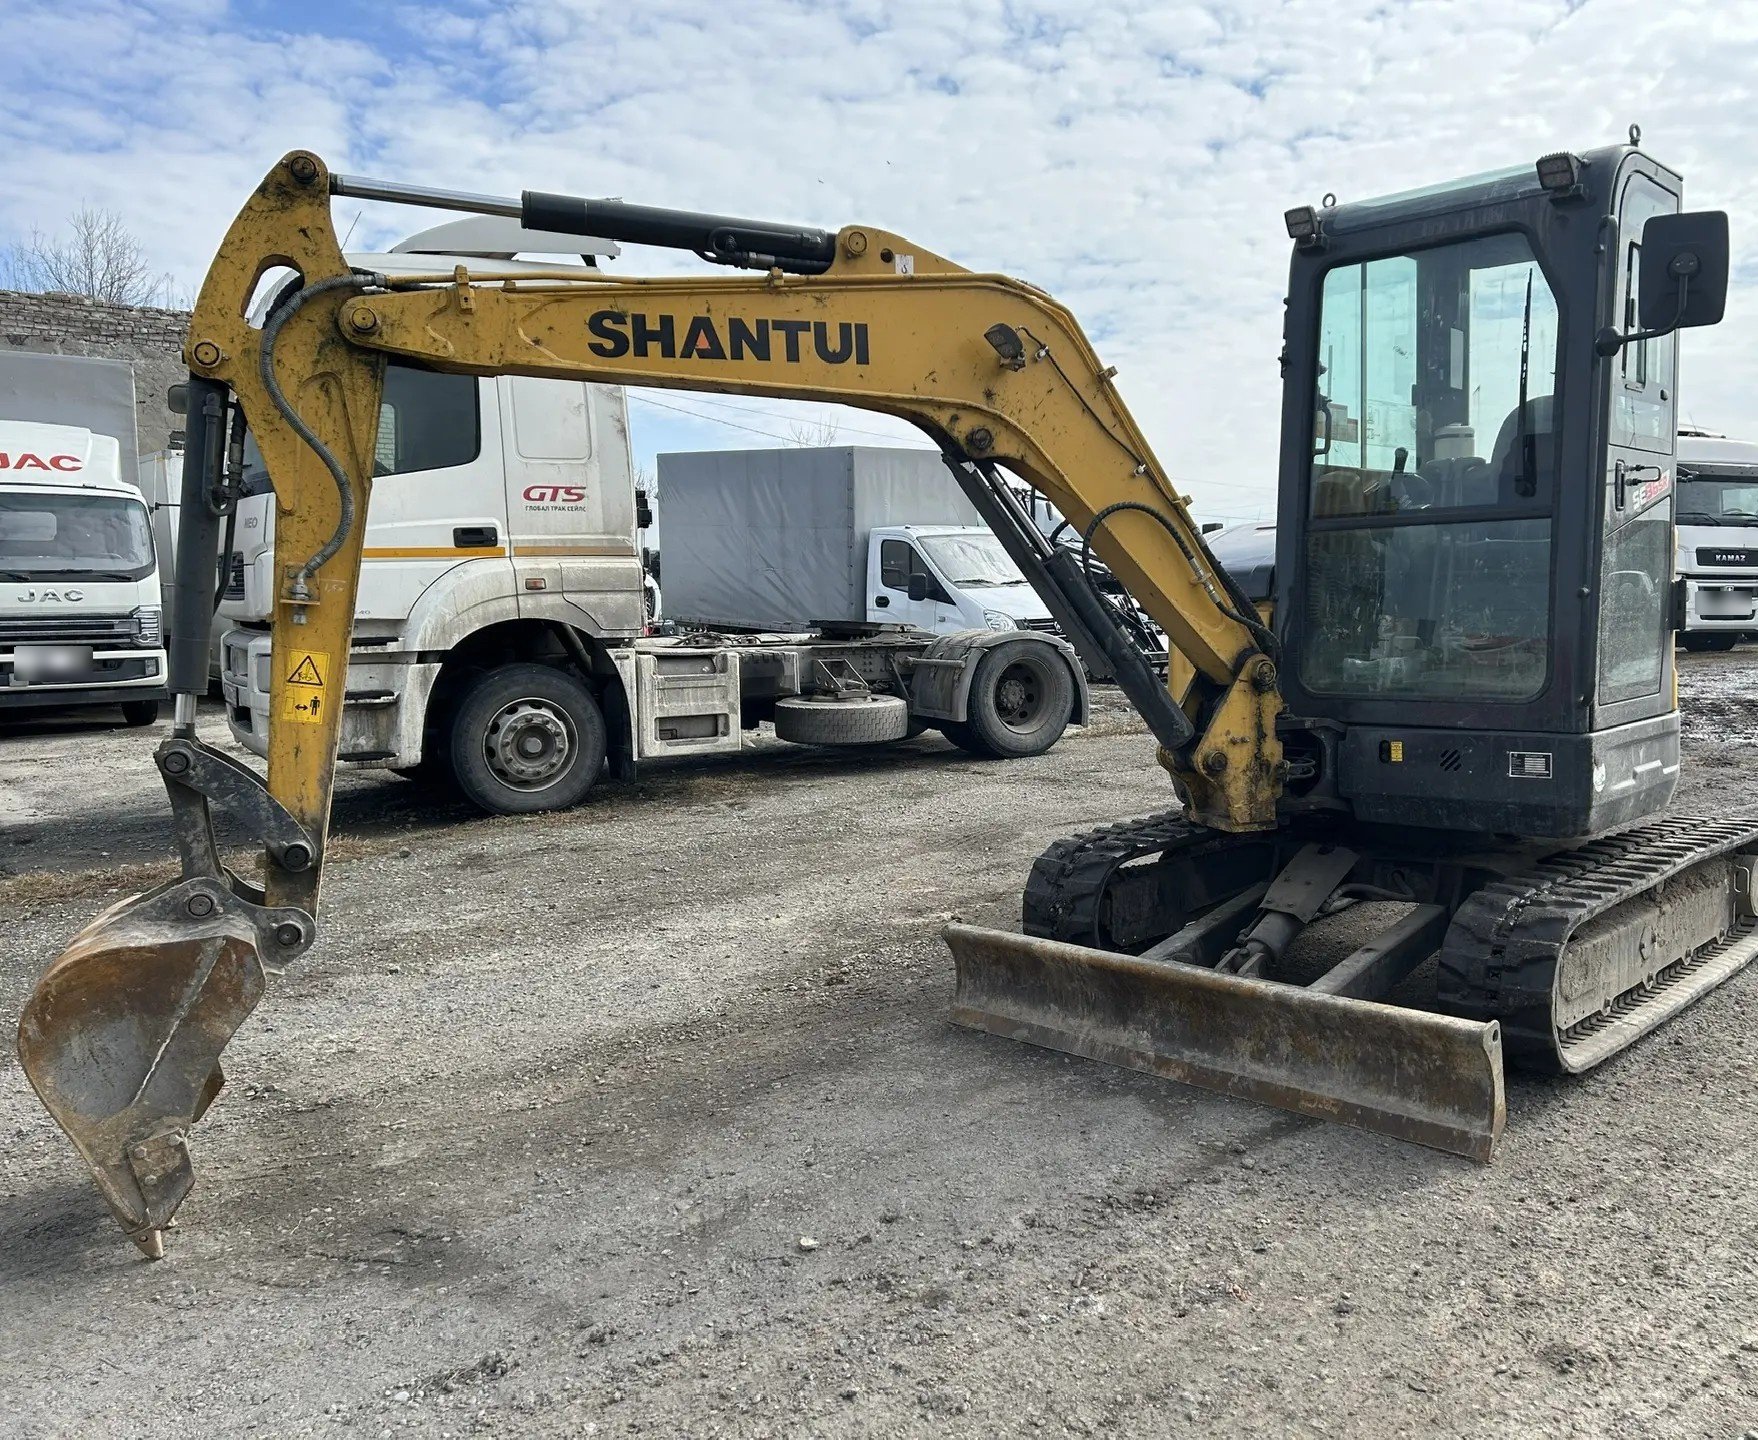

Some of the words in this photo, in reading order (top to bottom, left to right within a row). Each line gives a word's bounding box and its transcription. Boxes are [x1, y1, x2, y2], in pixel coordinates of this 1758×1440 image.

[587, 310, 870, 365] SHANTUI
[523, 486, 587, 502] GTS
[1715, 554, 1746, 562] KAMAZ
[17, 588, 85, 603] JAC
